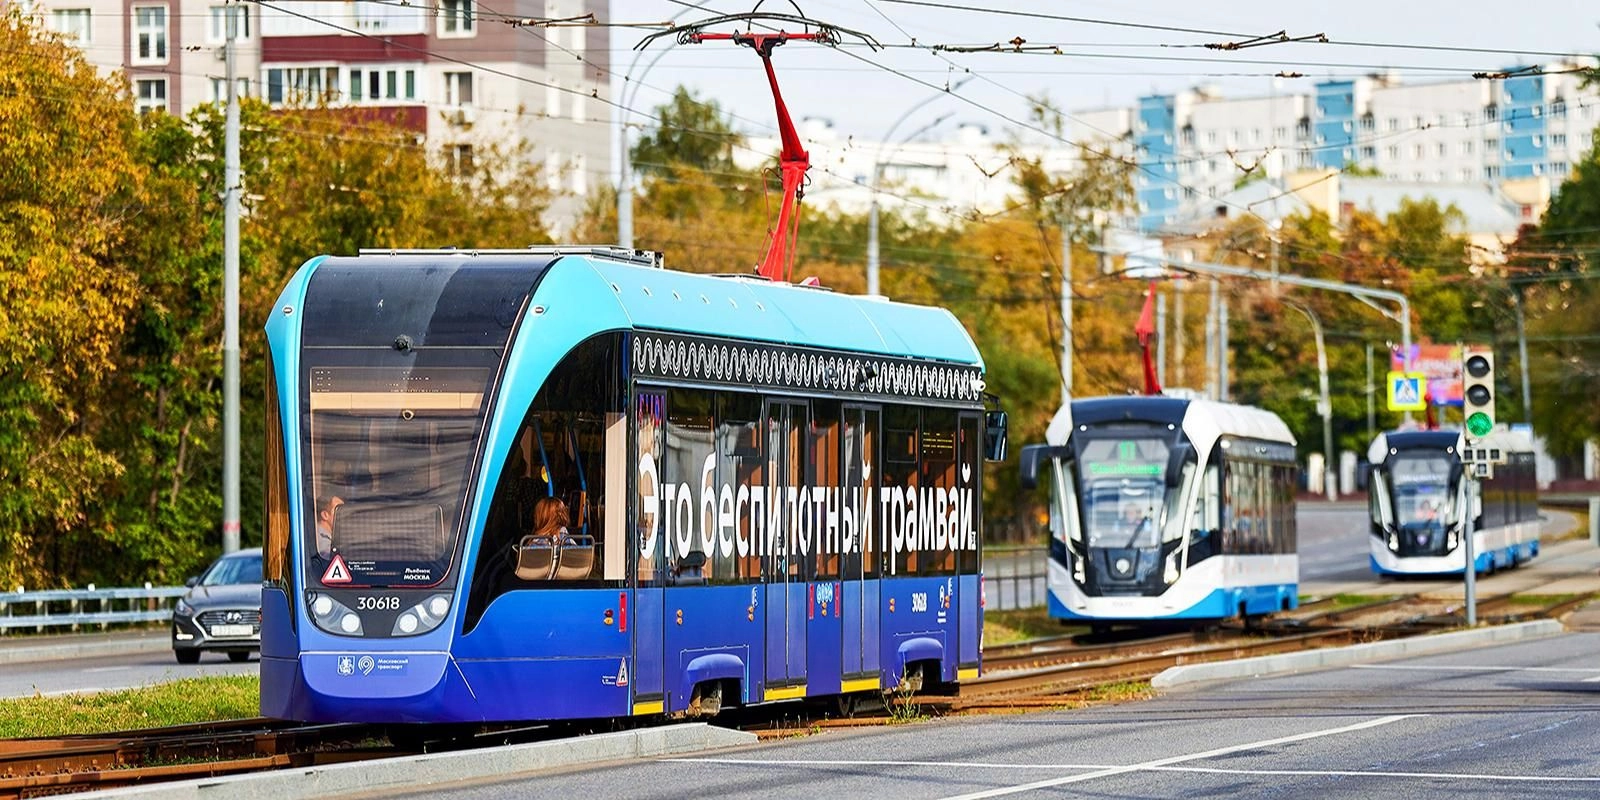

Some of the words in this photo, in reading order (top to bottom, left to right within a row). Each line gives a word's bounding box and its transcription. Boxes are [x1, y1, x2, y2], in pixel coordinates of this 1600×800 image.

[638, 452, 693, 560] Это
[700, 450, 873, 560] беспилотный
[880, 462, 974, 576] трамвай
[357, 597, 400, 610] 30618
